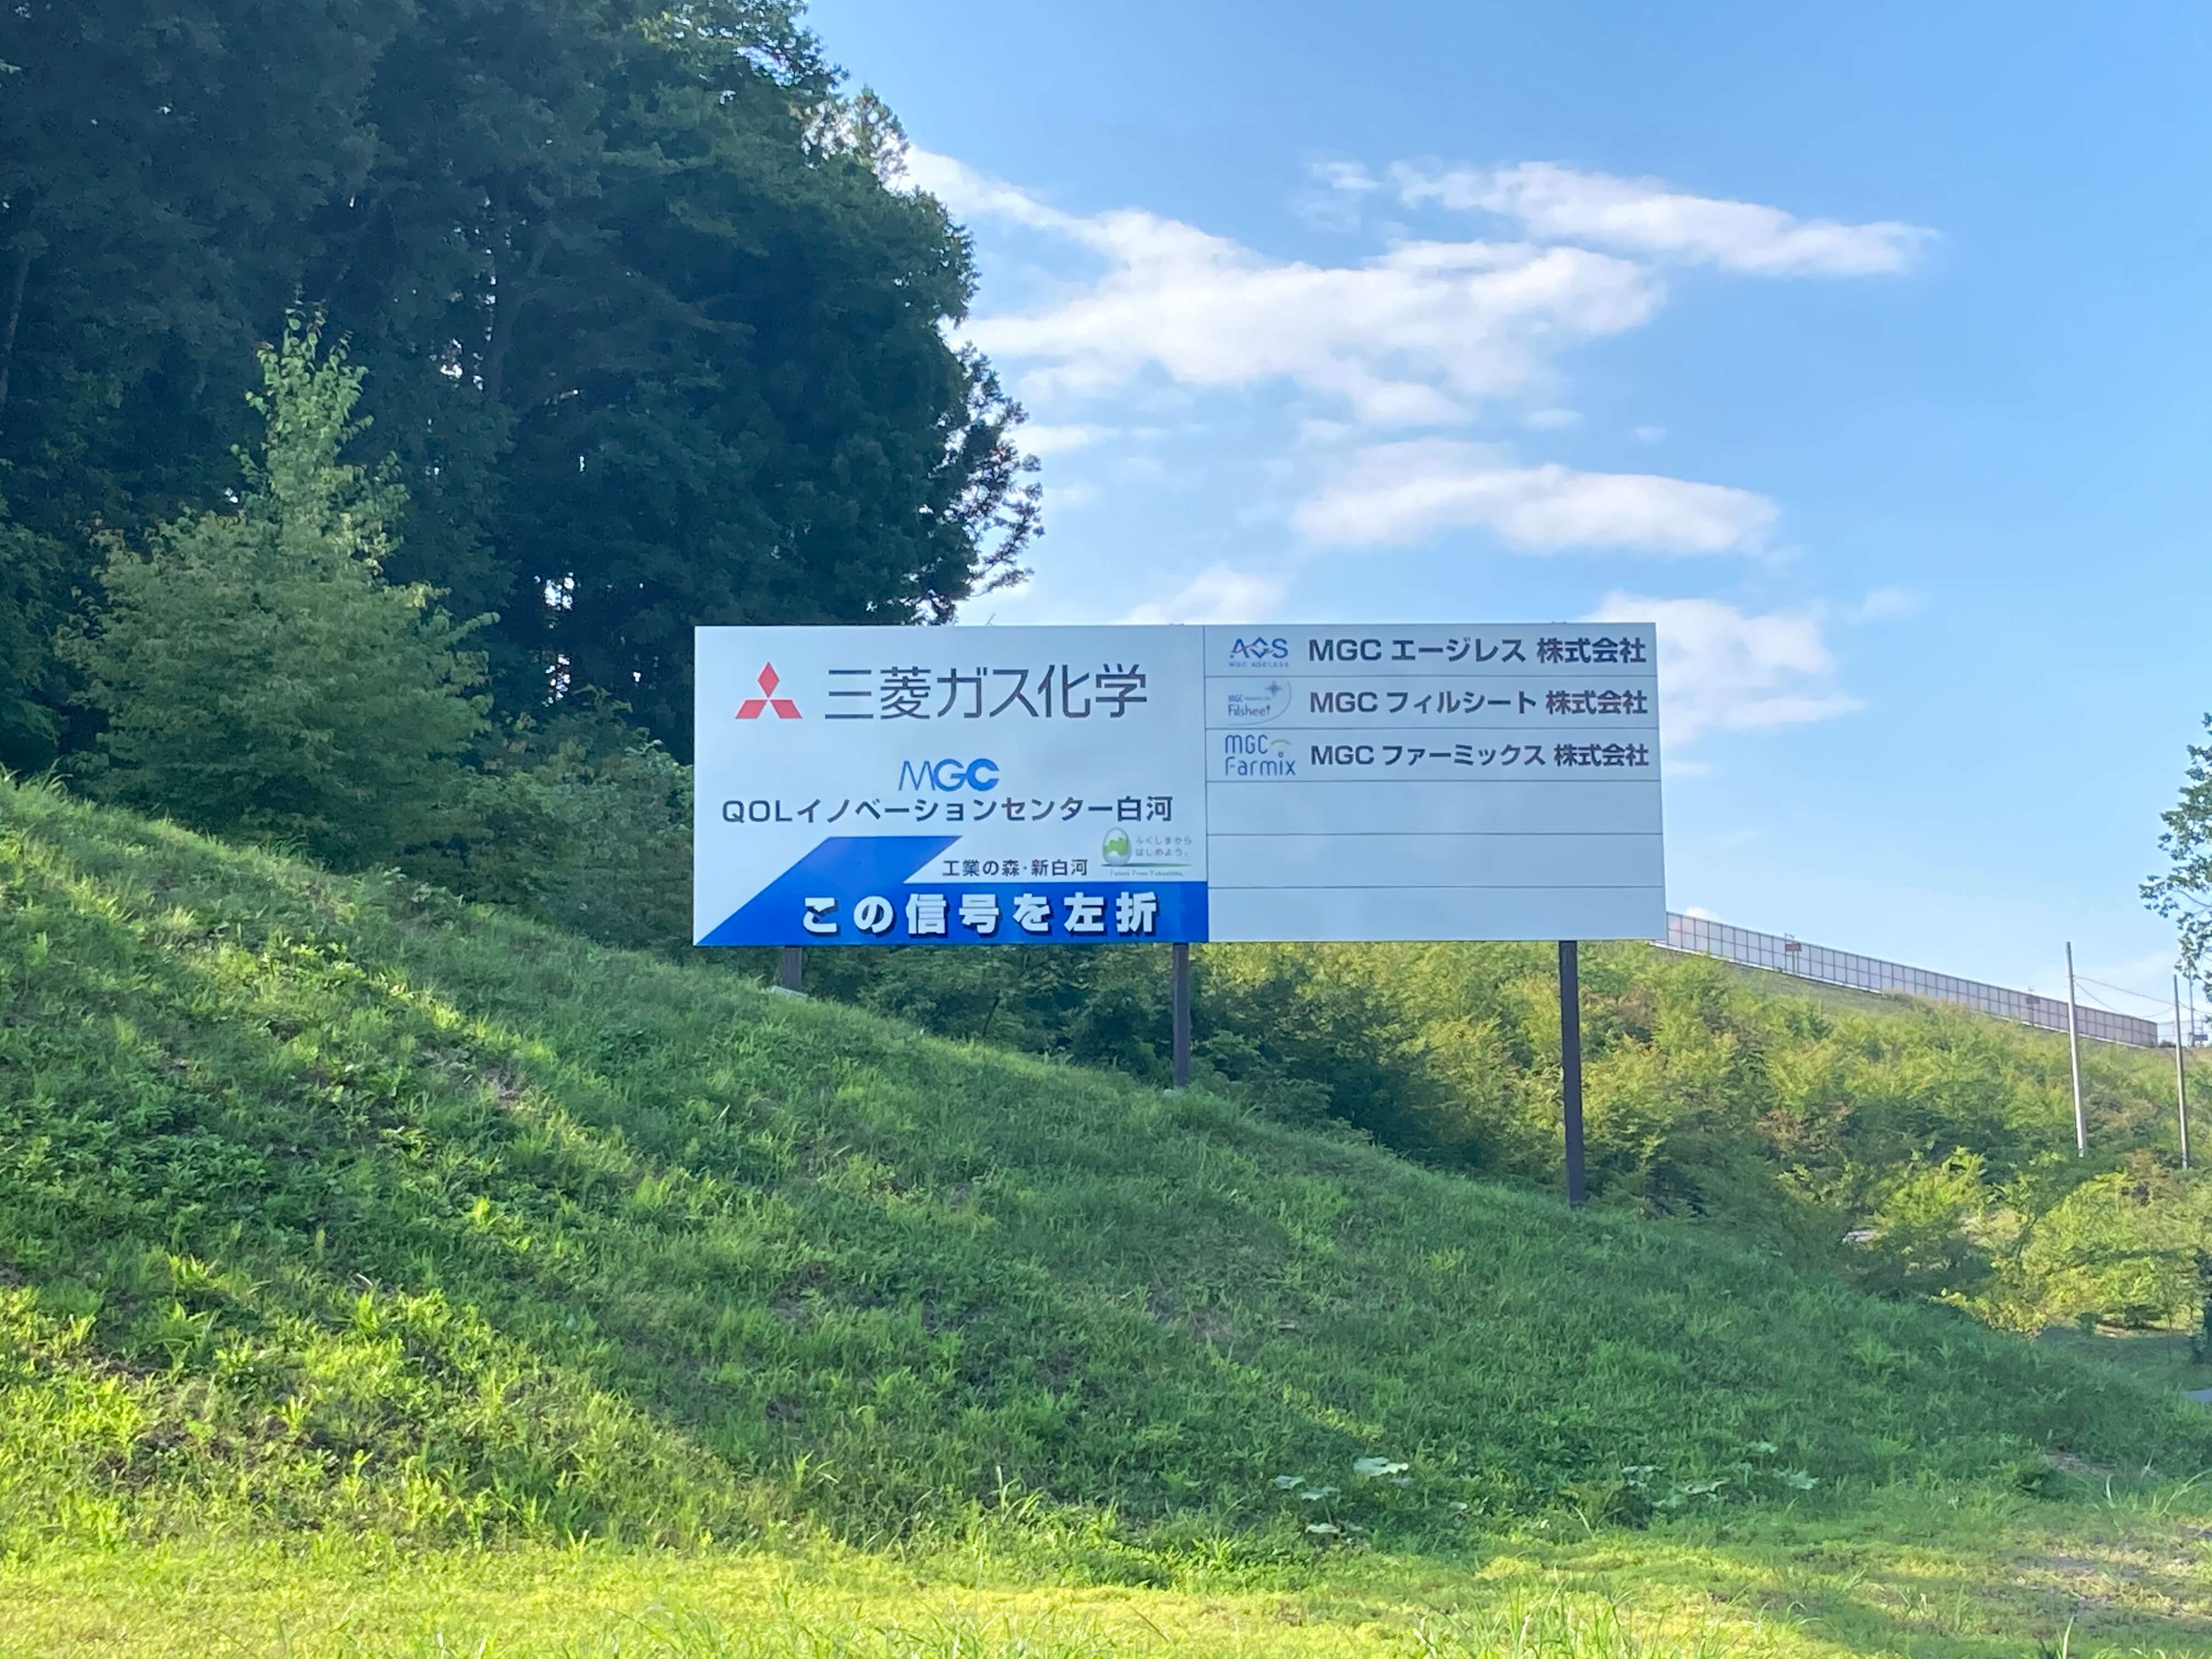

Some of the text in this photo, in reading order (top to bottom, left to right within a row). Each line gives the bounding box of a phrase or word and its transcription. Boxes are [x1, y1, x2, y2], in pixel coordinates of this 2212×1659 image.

[1309, 636, 1646, 663] MGC エージレス 株式会社
[825, 663, 1148, 719] 三菱ガス化学
[1310, 690, 1648, 714] MGC フィルシート 株式会社
[1225, 752, 1296, 776] Farmix
[1311, 743, 1649, 767] MGC ファーミックス 株式会社
[898, 758, 1000, 792] MGC
[722, 795, 1173, 823] QOLイノベーションセンター白河
[803, 891, 1158, 936] この信号を左折
